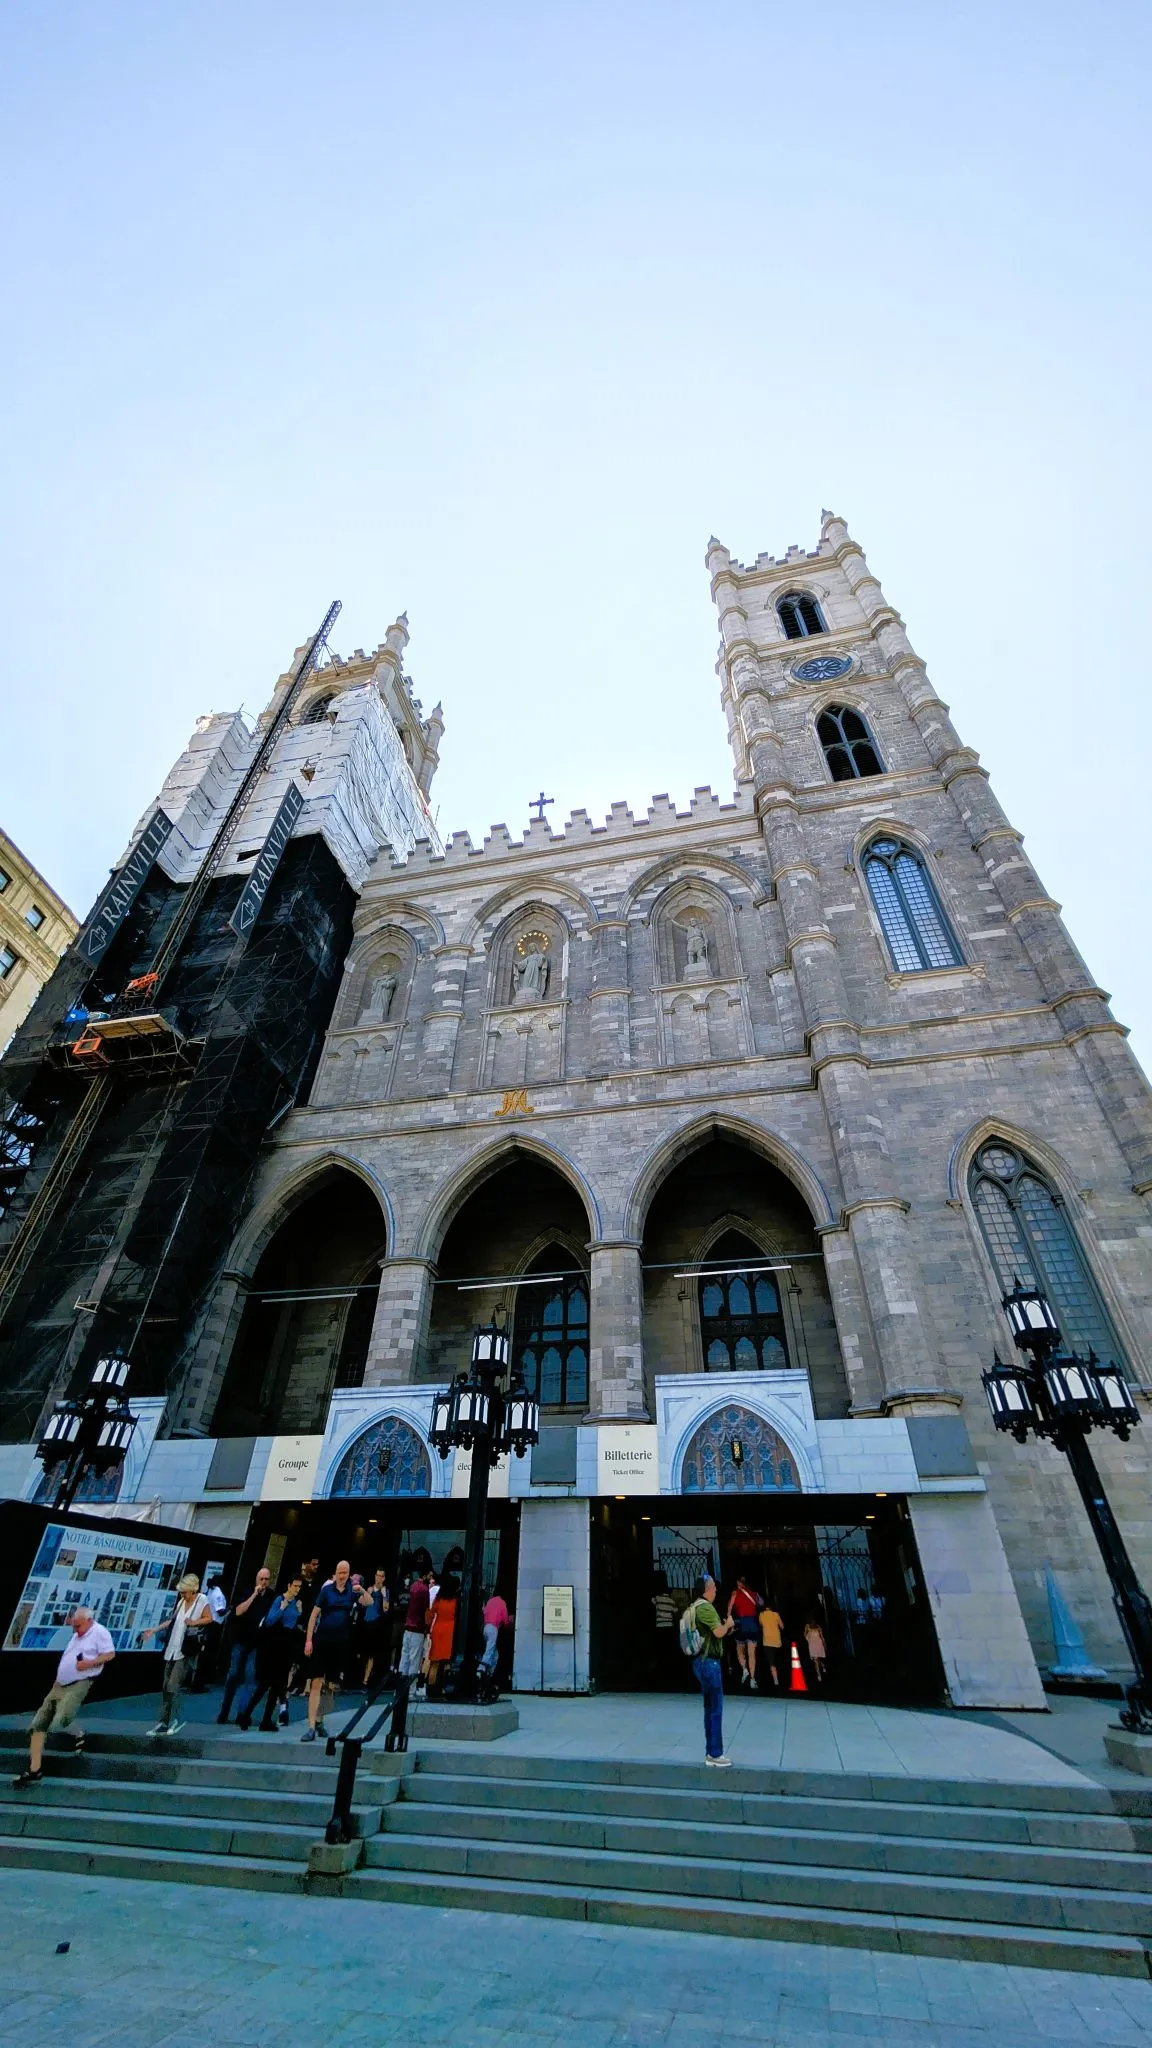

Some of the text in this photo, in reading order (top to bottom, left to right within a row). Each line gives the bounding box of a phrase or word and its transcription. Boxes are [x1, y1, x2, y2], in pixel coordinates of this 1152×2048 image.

[249, 788, 302, 902] RAINVILLE
[101, 815, 171, 928] RAINVILLE
[278, 1459, 309, 1470] Groupe
[604, 1450, 652, 1460] Billetterie
[64, 1531, 94, 1546] NOTRE
[93, 1536, 133, 1552] BASILIQUE
